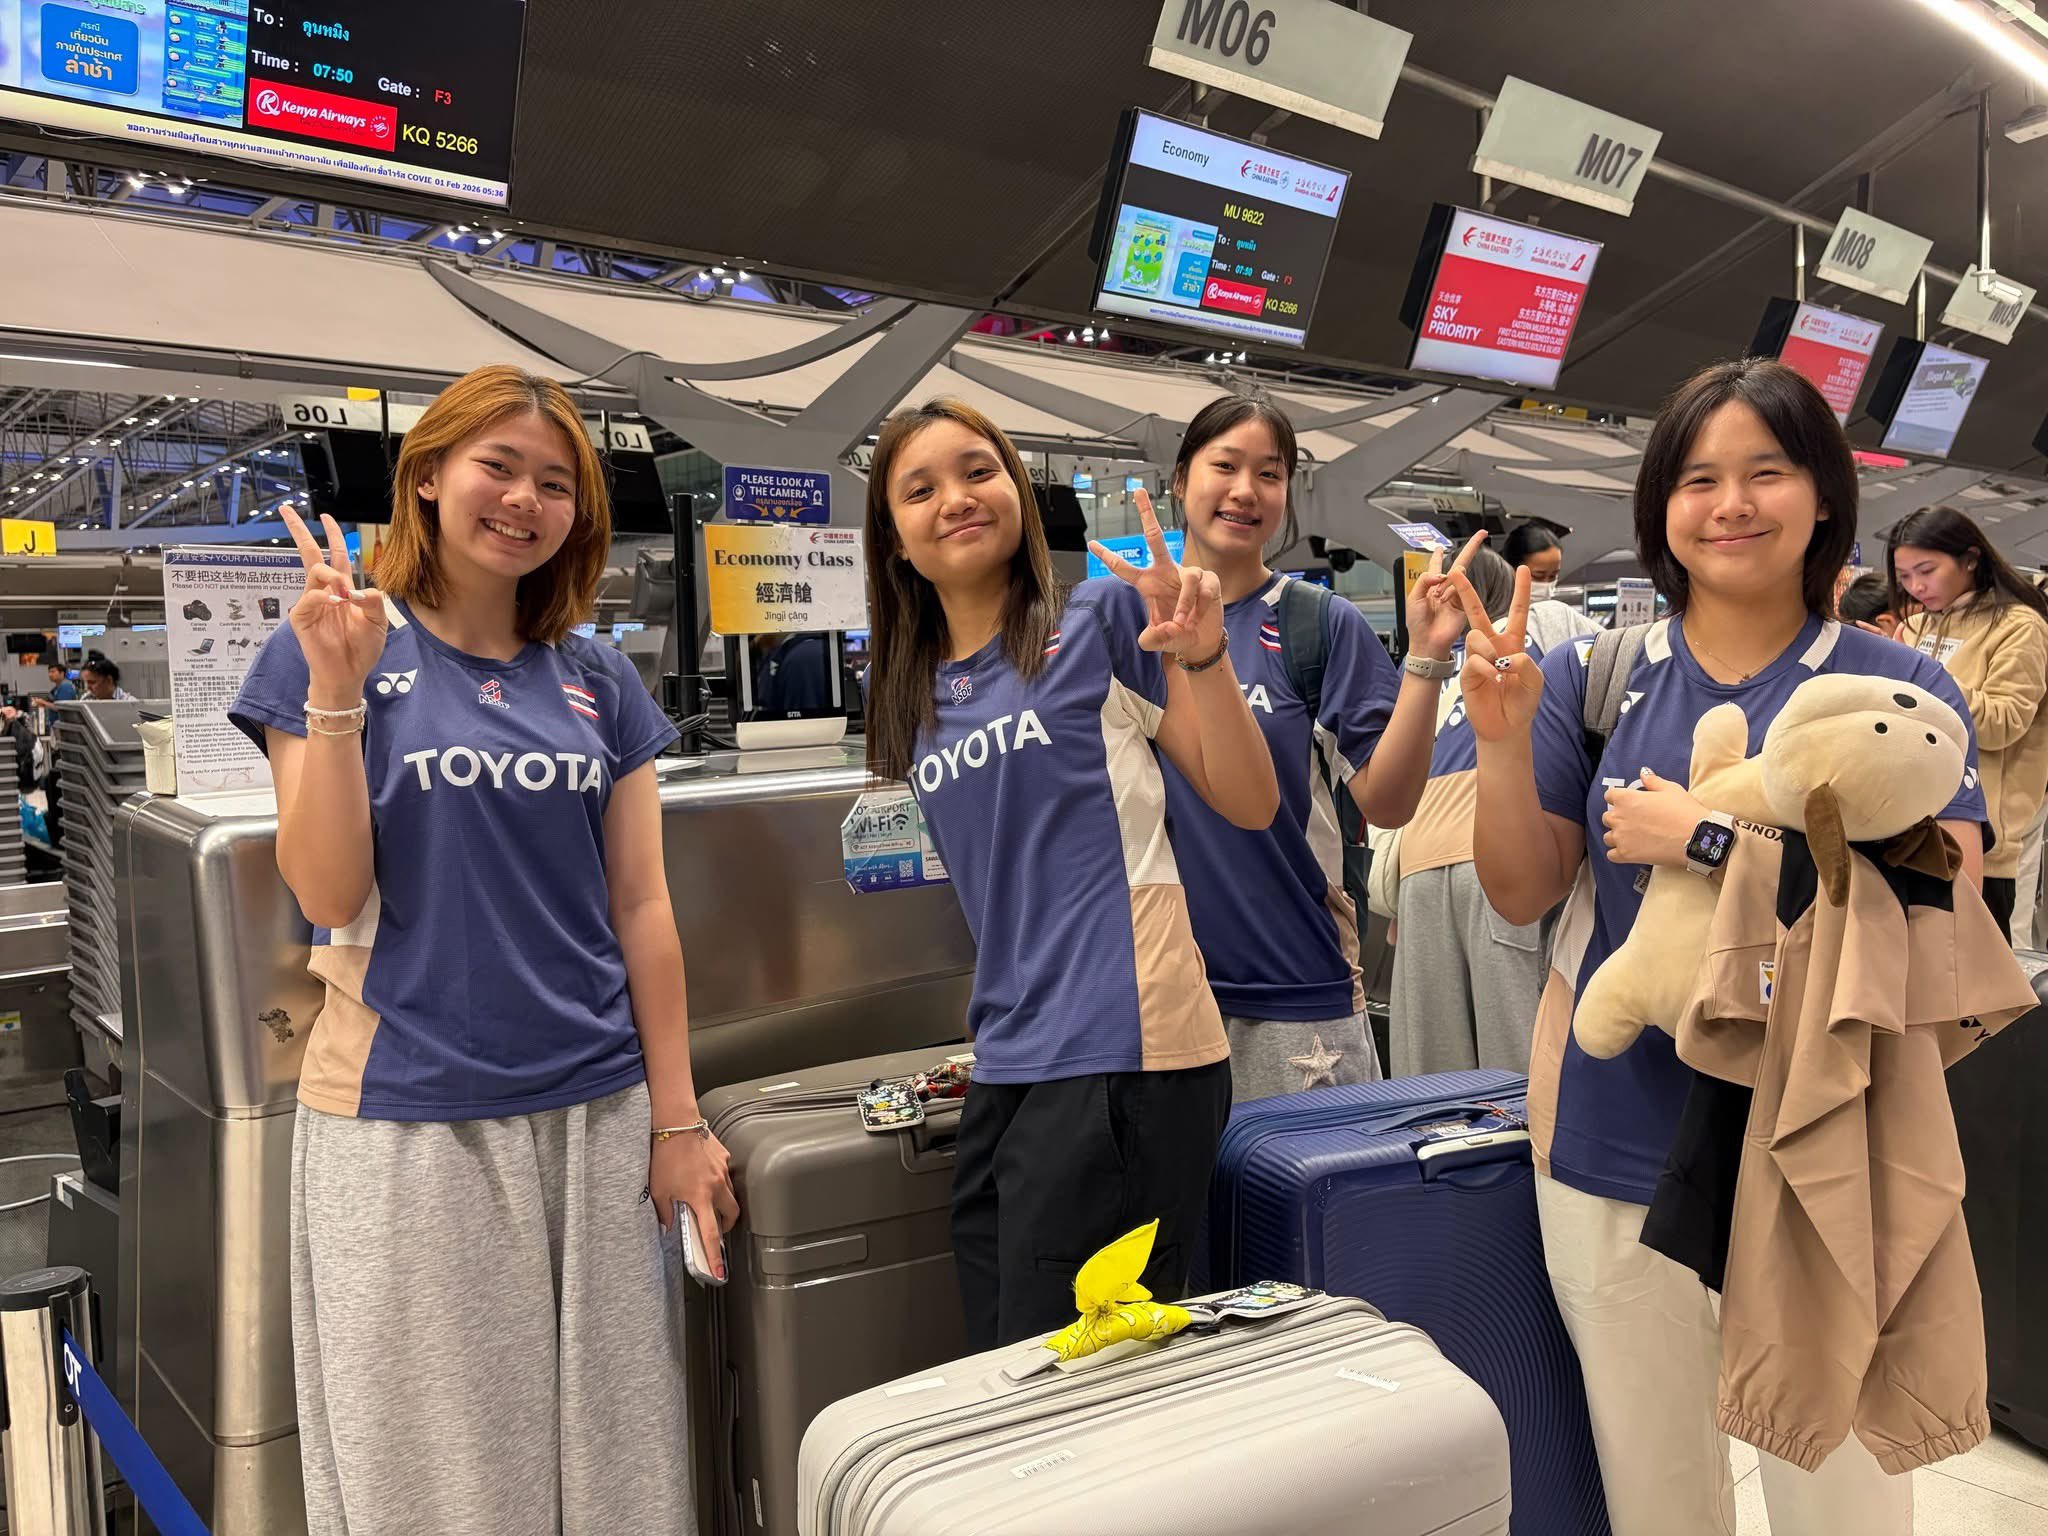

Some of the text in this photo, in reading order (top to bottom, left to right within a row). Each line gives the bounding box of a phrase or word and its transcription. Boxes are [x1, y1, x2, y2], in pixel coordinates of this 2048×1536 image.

[254, 8, 274, 25] To
[303, 19, 350, 42] คุนหมิง
[1177, 0, 1276, 66] M06
[56, 41, 122, 61] ภายในประเทศ
[252, 50, 290, 70] Time
[65, 54, 112, 80] ล่าช้า
[313, 64, 353, 83] 07:50
[378, 77, 411, 97] Gate
[435, 90, 452, 105] F3
[282, 100, 317, 118] Kenya
[319, 108, 366, 129] Airways
[403, 124, 479, 155] KQ 5266
[1162, 140, 1210, 167] Economy
[1576, 133, 1643, 189] M07
[435, 178, 504, 198] 01 Feb 2026 05:36
[1223, 203, 1265, 226] MU 9622
[1217, 234, 1227, 245] To
[1831, 227, 1876, 270] M08
[1212, 259, 1228, 272] Time
[1261, 270, 1276, 282] Gate
[1233, 291, 1253, 304] Airways
[1265, 298, 1279, 311] KQ
[1433, 305, 1458, 321] SKY
[1428, 320, 1482, 341] PRIORITY
[741, 474, 815, 488] PLEASE LOOK AT
[750, 486, 808, 499] THE CAMERA
[24, 530, 36, 551] J
[242, 555, 291, 563] ATTENTION
[714, 550, 854, 570] Economy Class
[756, 582, 812, 604] 經濟艙
[951, 683, 972, 705] NSDF
[907, 709, 1052, 801] TOYOTA
[404, 746, 602, 792] TOYOTA
[1716, 833, 1728, 848] 36
